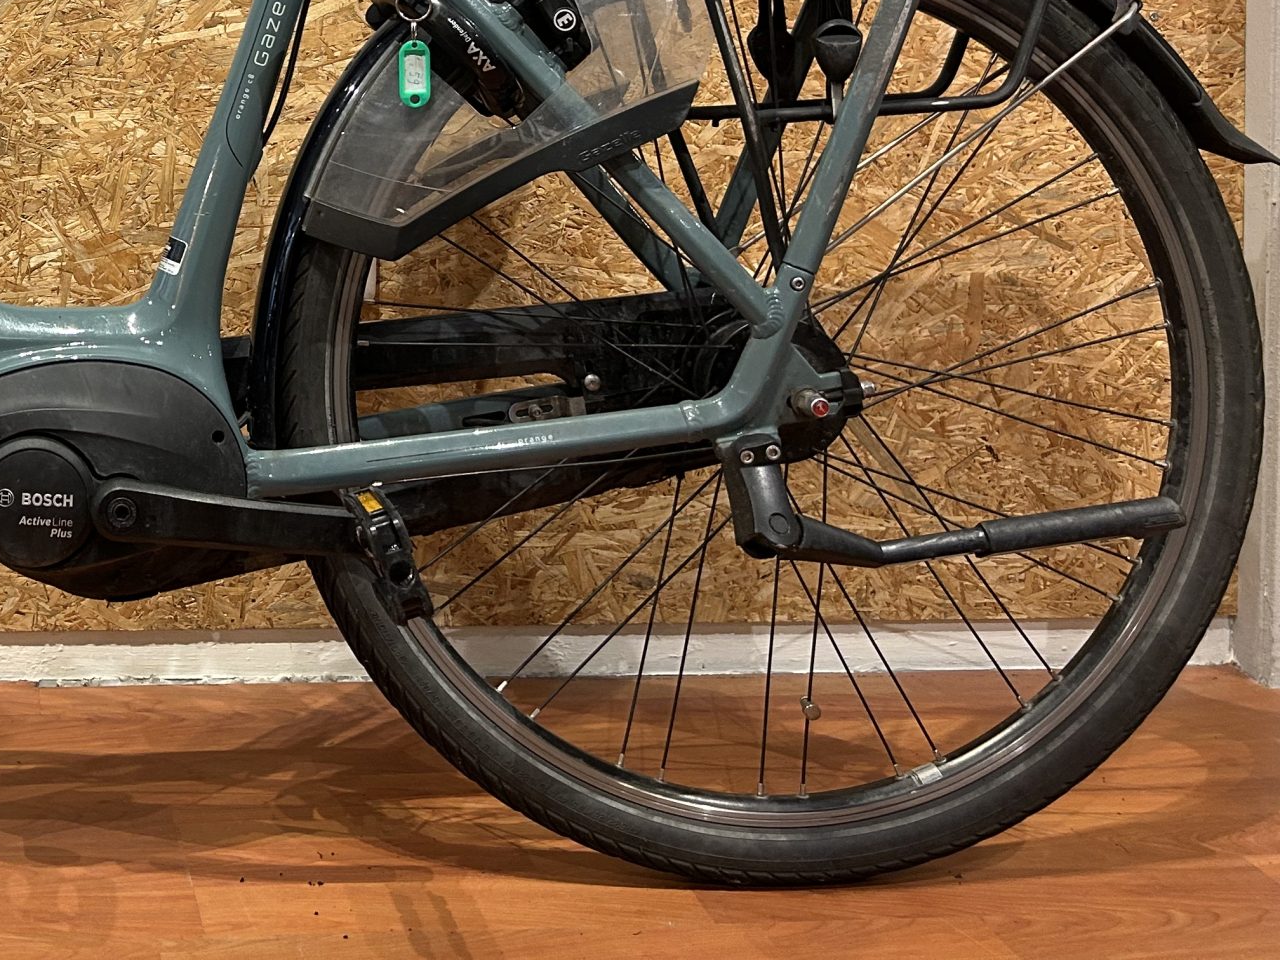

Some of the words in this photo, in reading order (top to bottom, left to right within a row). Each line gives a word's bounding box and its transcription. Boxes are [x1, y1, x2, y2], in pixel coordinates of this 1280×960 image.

[465, 41, 496, 73] AXA
[235, 87, 250, 120] orange
[21, 492, 73, 507] BOSCH
[19, 515, 52, 526] Active
[52, 517, 73, 527] Line
[49, 528, 73, 538] Plus
